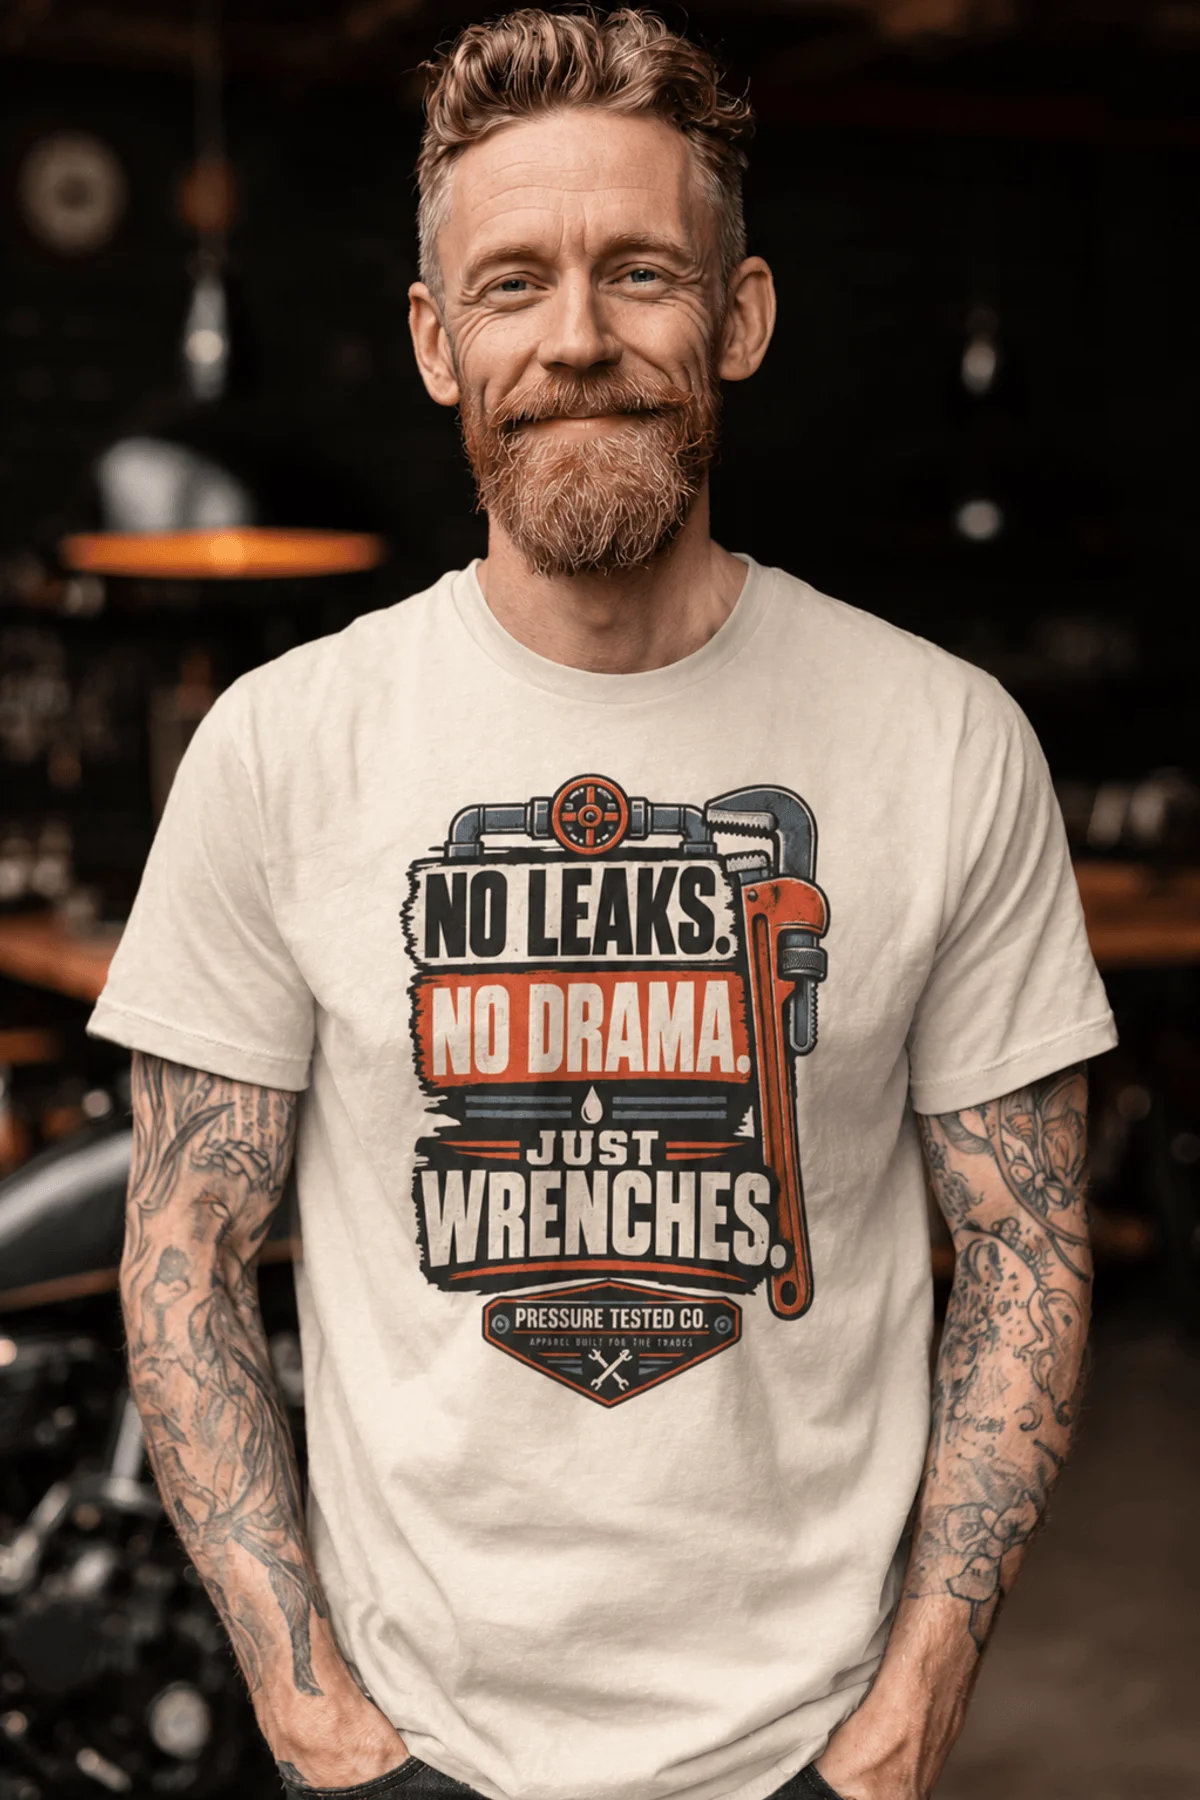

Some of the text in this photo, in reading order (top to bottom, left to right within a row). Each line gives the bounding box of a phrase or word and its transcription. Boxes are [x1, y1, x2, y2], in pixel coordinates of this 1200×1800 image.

[425, 866, 731, 959] NO LEAKS.
[432, 979, 751, 1077] NO DRAMA.
[525, 1129, 660, 1167] JUST
[421, 1169, 788, 1269] WRENCHES.
[515, 1308, 710, 1330] PRESSURE TESTED CO.
[633, 1337, 651, 1347] THE
